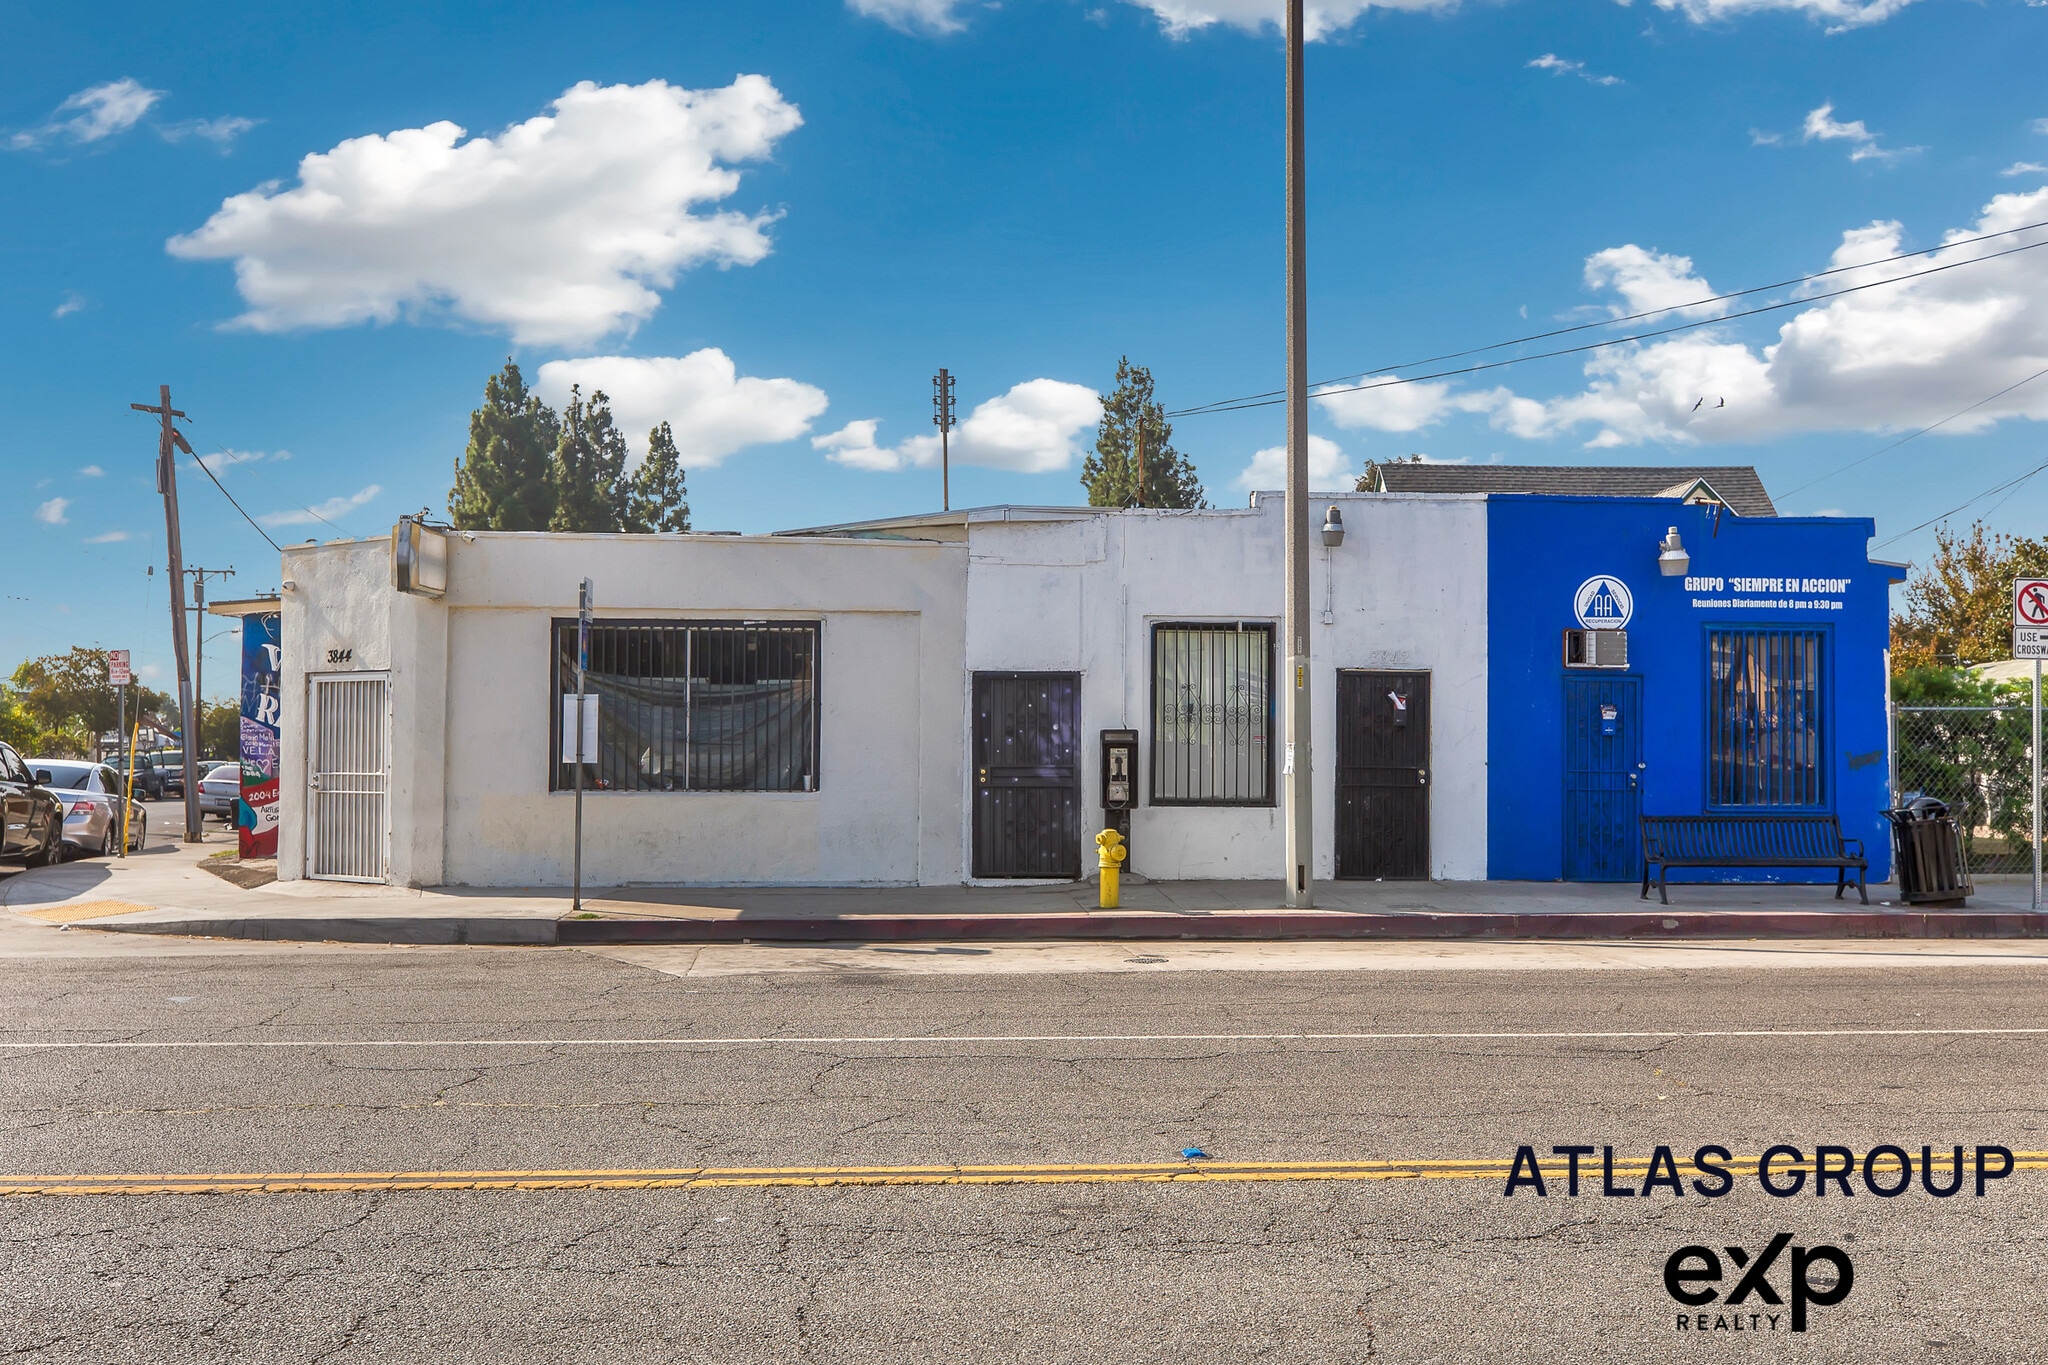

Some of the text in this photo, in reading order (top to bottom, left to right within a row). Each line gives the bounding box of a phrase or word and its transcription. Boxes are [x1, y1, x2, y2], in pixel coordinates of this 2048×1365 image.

[1684, 576, 1724, 592] GRUPO
[1786, 578, 1800, 593] EN
[1594, 594, 1612, 617] AA
[1692, 598, 1732, 608] Reuniones
[1732, 598, 1778, 609] Diariamente
[1778, 599, 1788, 609] de
[1788, 600, 1794, 609] 8
[1794, 601, 1807, 610] pm
[1813, 601, 1830, 610] 9:30
[1830, 602, 1843, 611] pm
[2020, 632, 2037, 642] USE
[110, 651, 119, 660] NO
[327, 648, 353, 664] 3844
[2017, 644, 2048, 655] CROSSW
